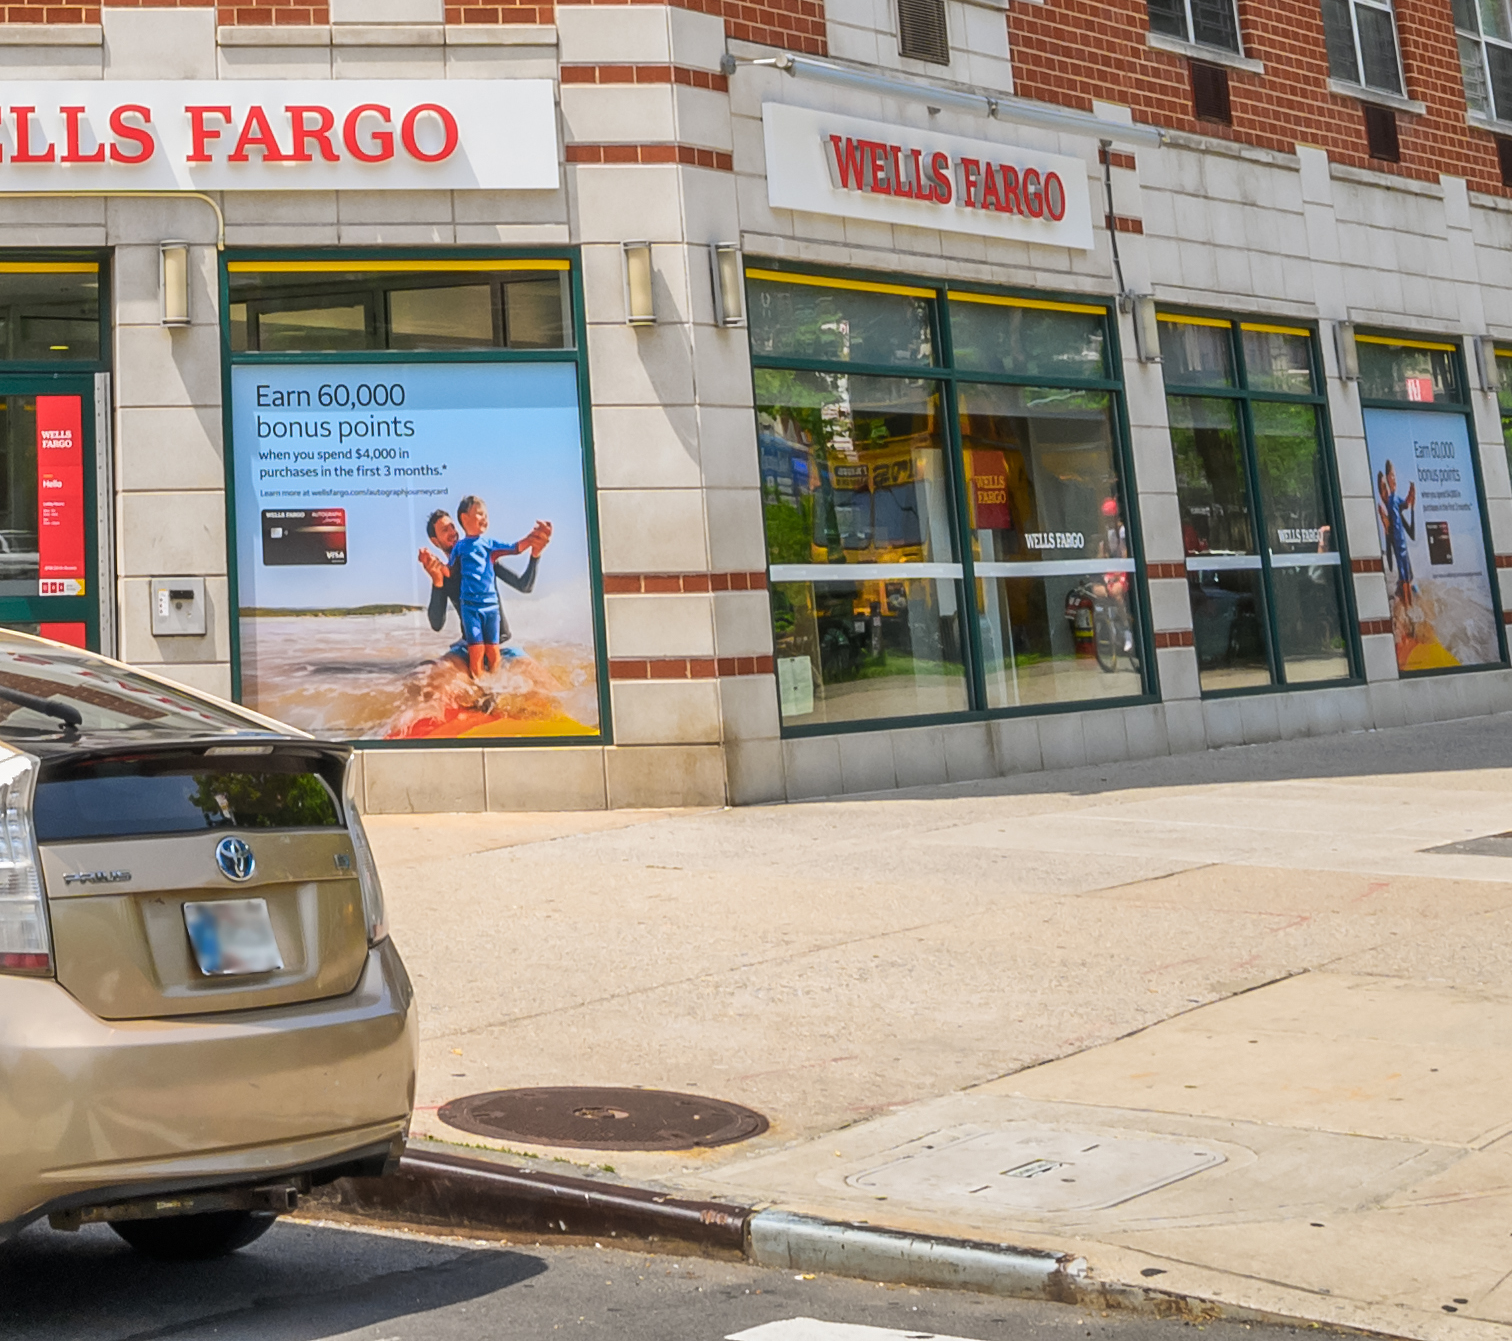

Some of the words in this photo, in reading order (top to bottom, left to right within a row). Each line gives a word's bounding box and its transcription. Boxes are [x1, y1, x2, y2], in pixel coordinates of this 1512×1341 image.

[184, 103, 460, 164] FARGO
[826, 133, 953, 205] WELLS
[959, 156, 1067, 222] FARGO
[256, 384, 311, 407] Earn
[318, 383, 406, 410] 60,000
[41, 430, 72, 440] WELLS
[257, 415, 332, 438] bonus
[339, 414, 415, 444] points
[42, 439, 73, 449] FARGO
[1413, 440, 1429, 459] Earn
[1430, 441, 1455, 460] 60,000
[258, 448, 291, 460] when
[293, 451, 315, 463] you
[317, 448, 352, 463] spend
[355, 447, 396, 462] $4,000
[398, 448, 410, 460] in
[259, 466, 319, 480] purchases
[321, 466, 332, 477] in
[334, 465, 354, 477] the
[356, 464, 381, 477] first
[383, 465, 392, 477] 3
[1417, 464, 1439, 483] bonus
[1439, 464, 1461, 487] points
[42, 479, 63, 489] Hello
[975, 475, 1005, 490] WELLS
[260, 489, 281, 497] Learn
[977, 490, 1007, 505] FARGO
[1024, 532, 1056, 550] WELLS
[1055, 531, 1085, 549] FARGO
[1277, 528, 1302, 544] WELLS
[326, 550, 345, 559] VISA
[63, 870, 132, 885] PRIUS
